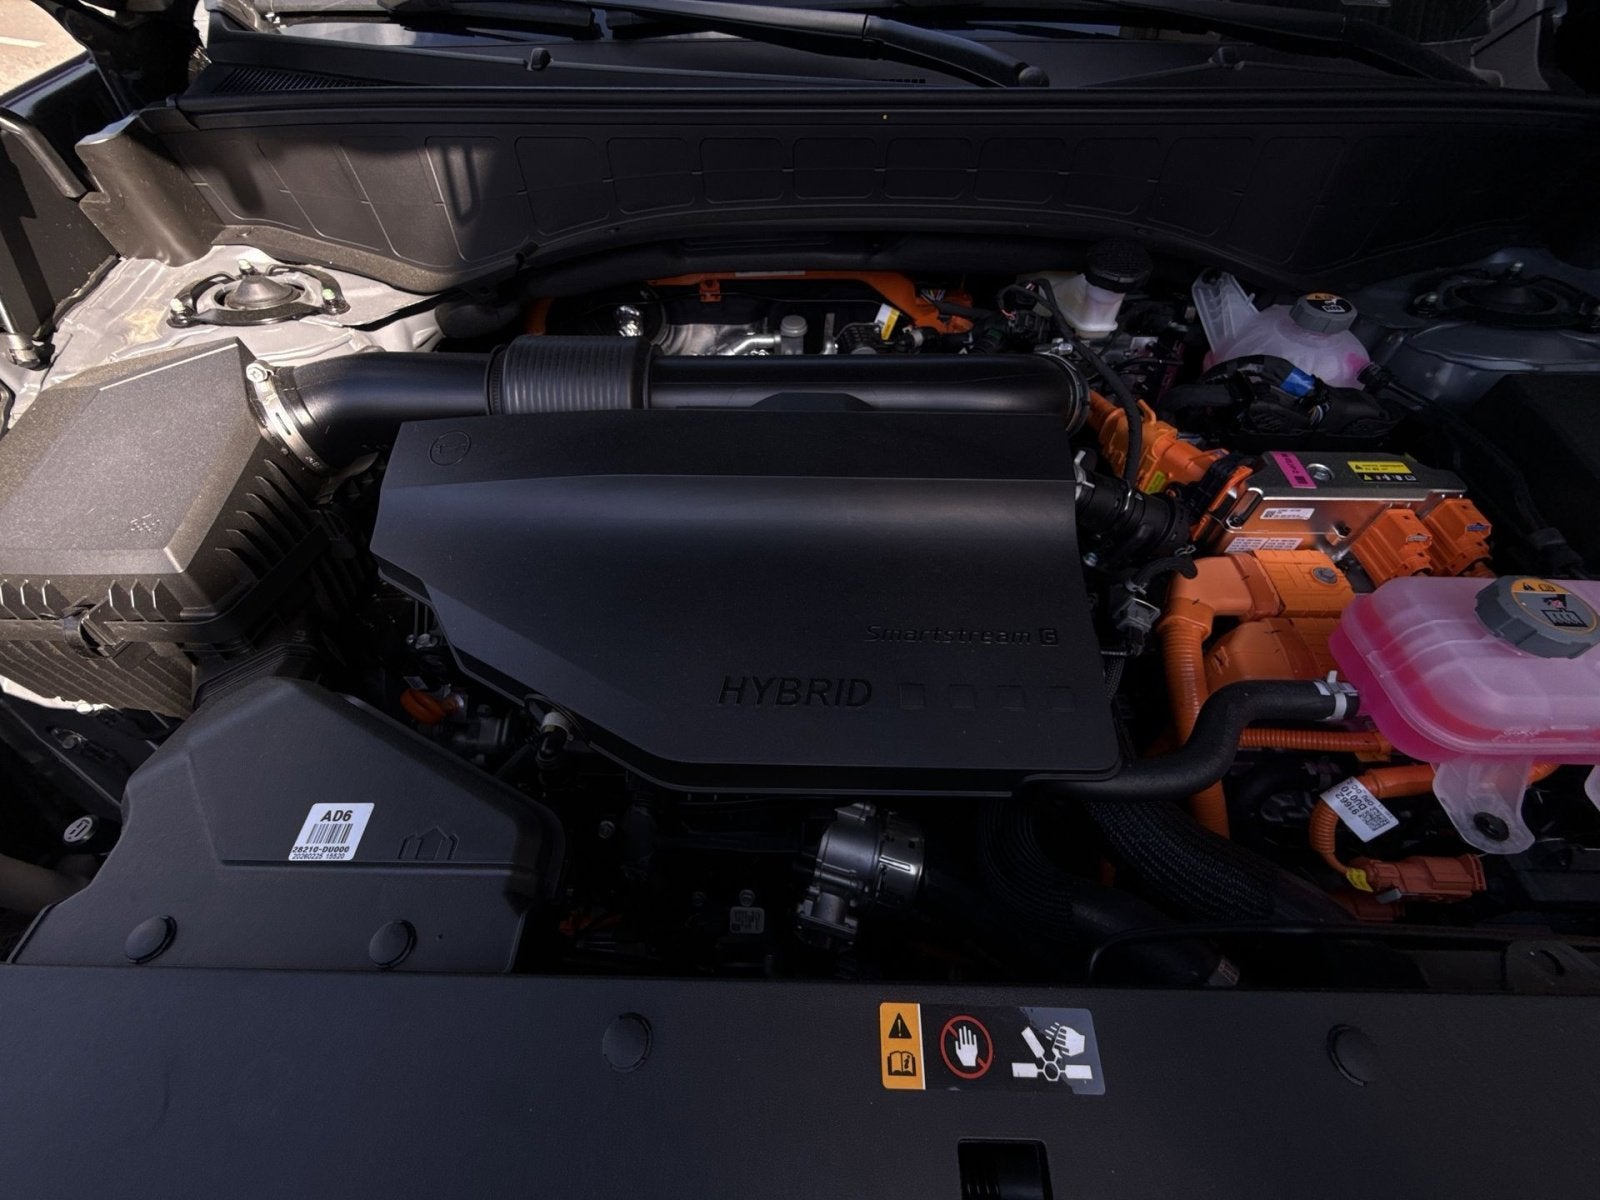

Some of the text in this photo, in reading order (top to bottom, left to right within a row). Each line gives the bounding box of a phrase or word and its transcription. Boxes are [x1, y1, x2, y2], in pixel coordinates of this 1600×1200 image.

[865, 624, 1058, 646] Smartstream G
[718, 675, 873, 708] HYBRID
[1335, 791, 1360, 815] 91662
[1341, 786, 1368, 810] DU010
[320, 810, 353, 822] AD6
